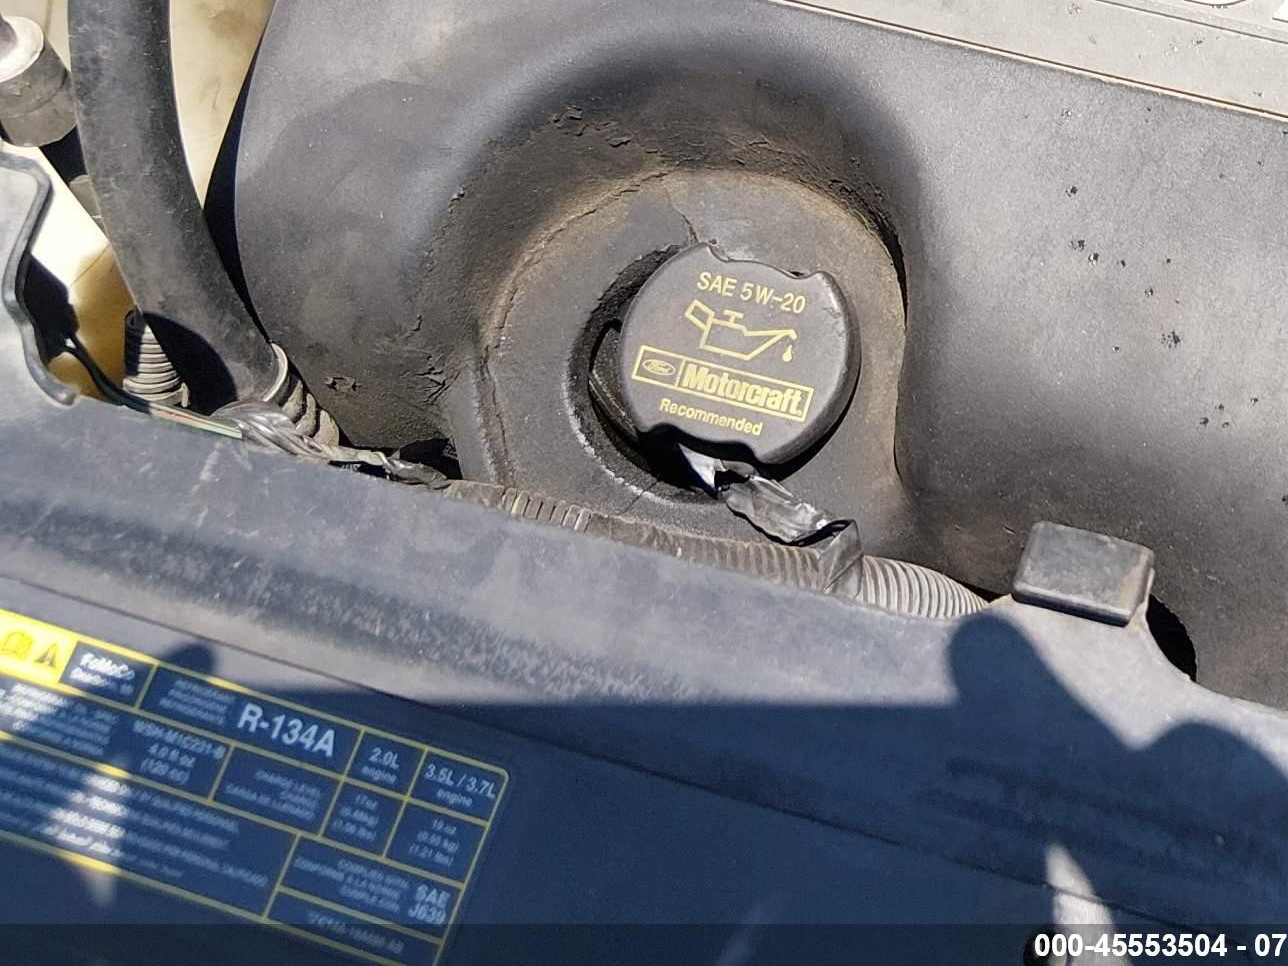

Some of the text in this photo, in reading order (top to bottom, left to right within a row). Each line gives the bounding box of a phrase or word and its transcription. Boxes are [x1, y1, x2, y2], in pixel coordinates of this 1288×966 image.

[696, 271, 806, 315] SAE 5W-20
[659, 398, 764, 436] Recommended
[238, 703, 335, 757] R-134A
[368, 746, 400, 771] 2.0L
